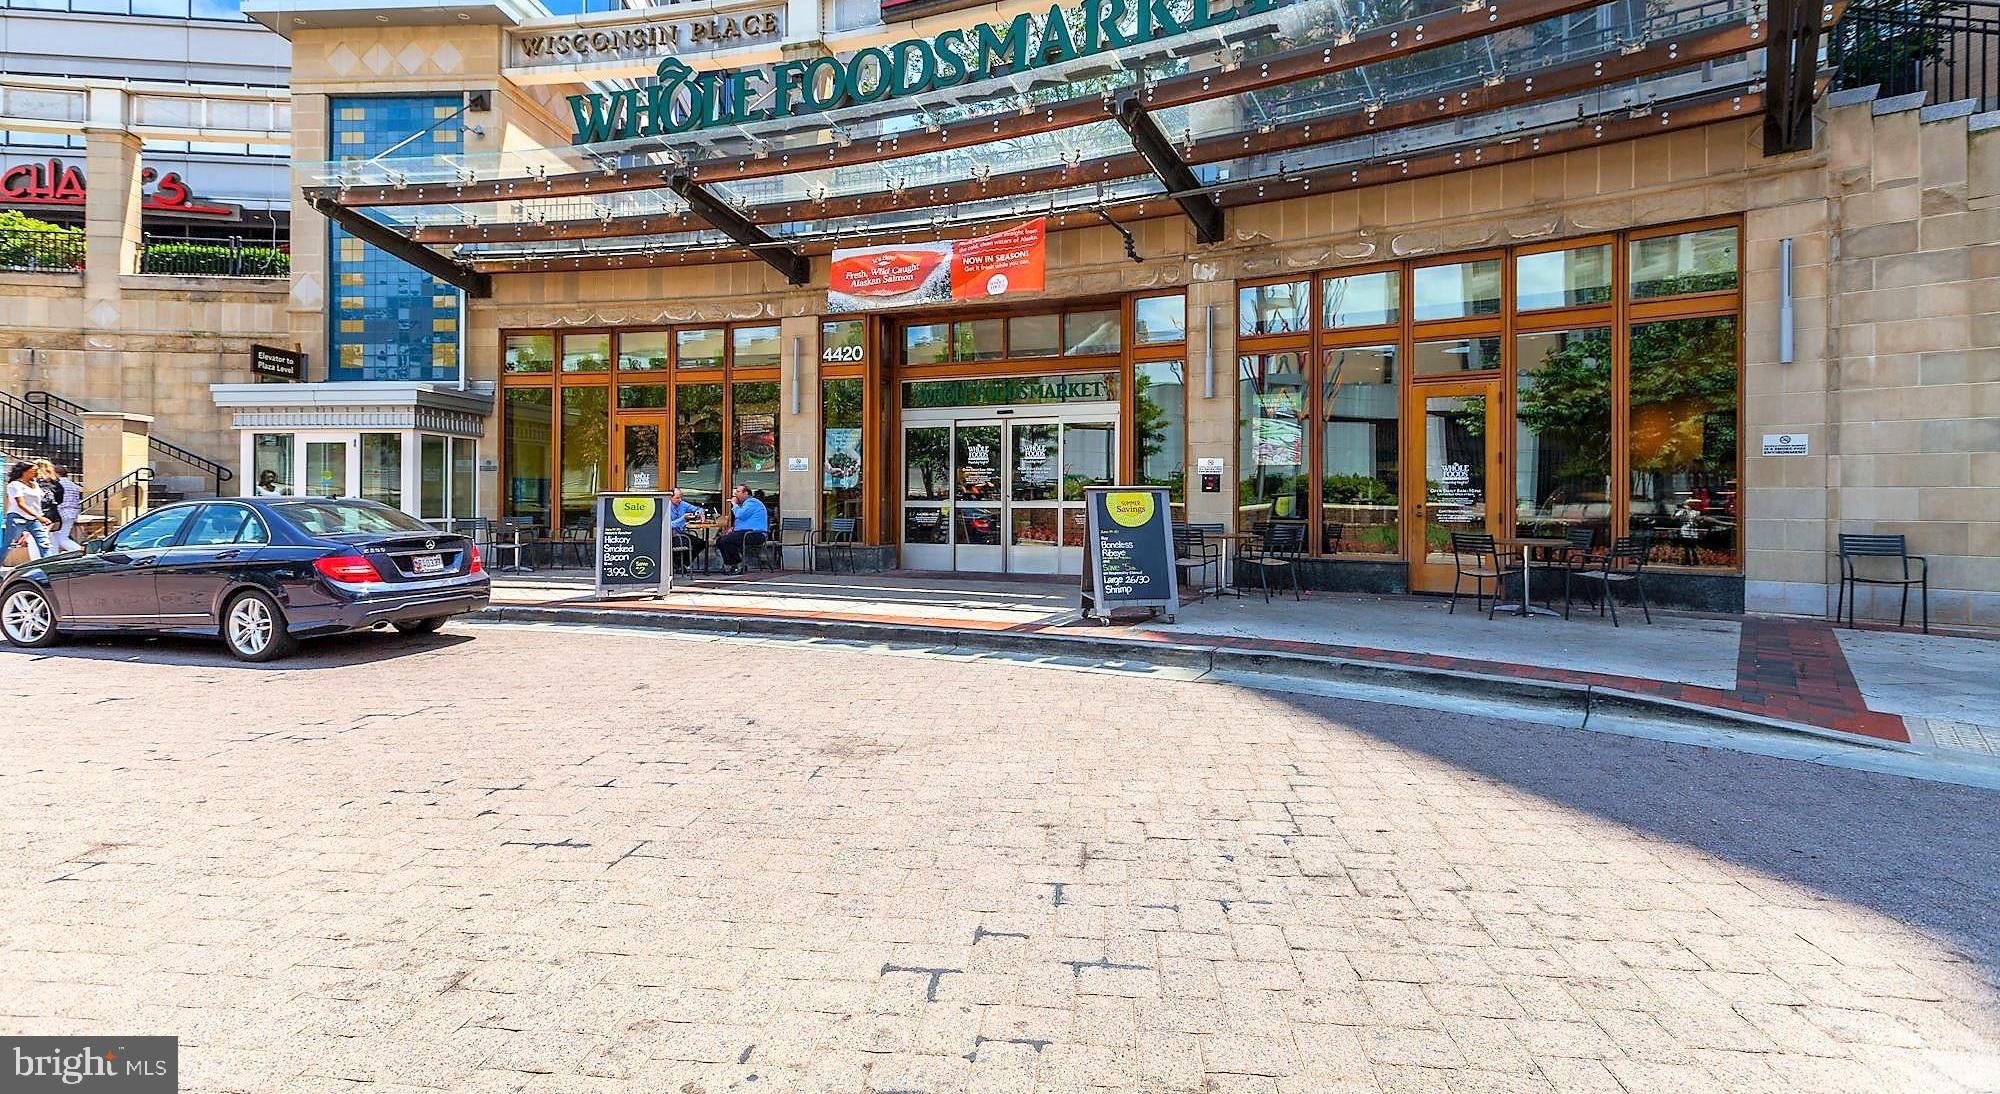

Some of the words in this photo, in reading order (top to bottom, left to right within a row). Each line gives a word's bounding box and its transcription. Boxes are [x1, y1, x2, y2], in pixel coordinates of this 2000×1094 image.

[520, 24, 679, 57] WISCONSIN
[690, 11, 776, 42] PLACE
[566, 56, 767, 144] WHOLE
[969, 0, 1277, 73] MARKE
[962, 257, 984, 265] NOW
[985, 255, 995, 263] IN
[995, 250, 1029, 262] SEASON!
[845, 270, 868, 279] Fresh,
[871, 267, 890, 276] Wild
[892, 263, 919, 274] Caught
[851, 278, 882, 288] Alaskan
[882, 274, 913, 284] Salmon
[257, 352, 286, 363] Elevator
[823, 345, 863, 361] 4420
[257, 361, 276, 371] Plaza
[276, 364, 294, 374] Level
[968, 443, 989, 453] WHOLE
[1024, 442, 1047, 452] WHOLE
[1441, 462, 1469, 472] WHOLE
[624, 502, 645, 511] Sale
[1116, 505, 1146, 515] Savings
[604, 536, 631, 544] Hickory
[1101, 541, 1134, 549] Boneless
[604, 544, 634, 552] Smoked
[1102, 548, 1126, 558] Ribeye
[604, 552, 630, 562] Bacon
[1103, 564, 1120, 572] Save
[1104, 576, 1124, 586] Large
[1124, 576, 1150, 584] 26/30
[1105, 585, 1133, 595] Shrimp
